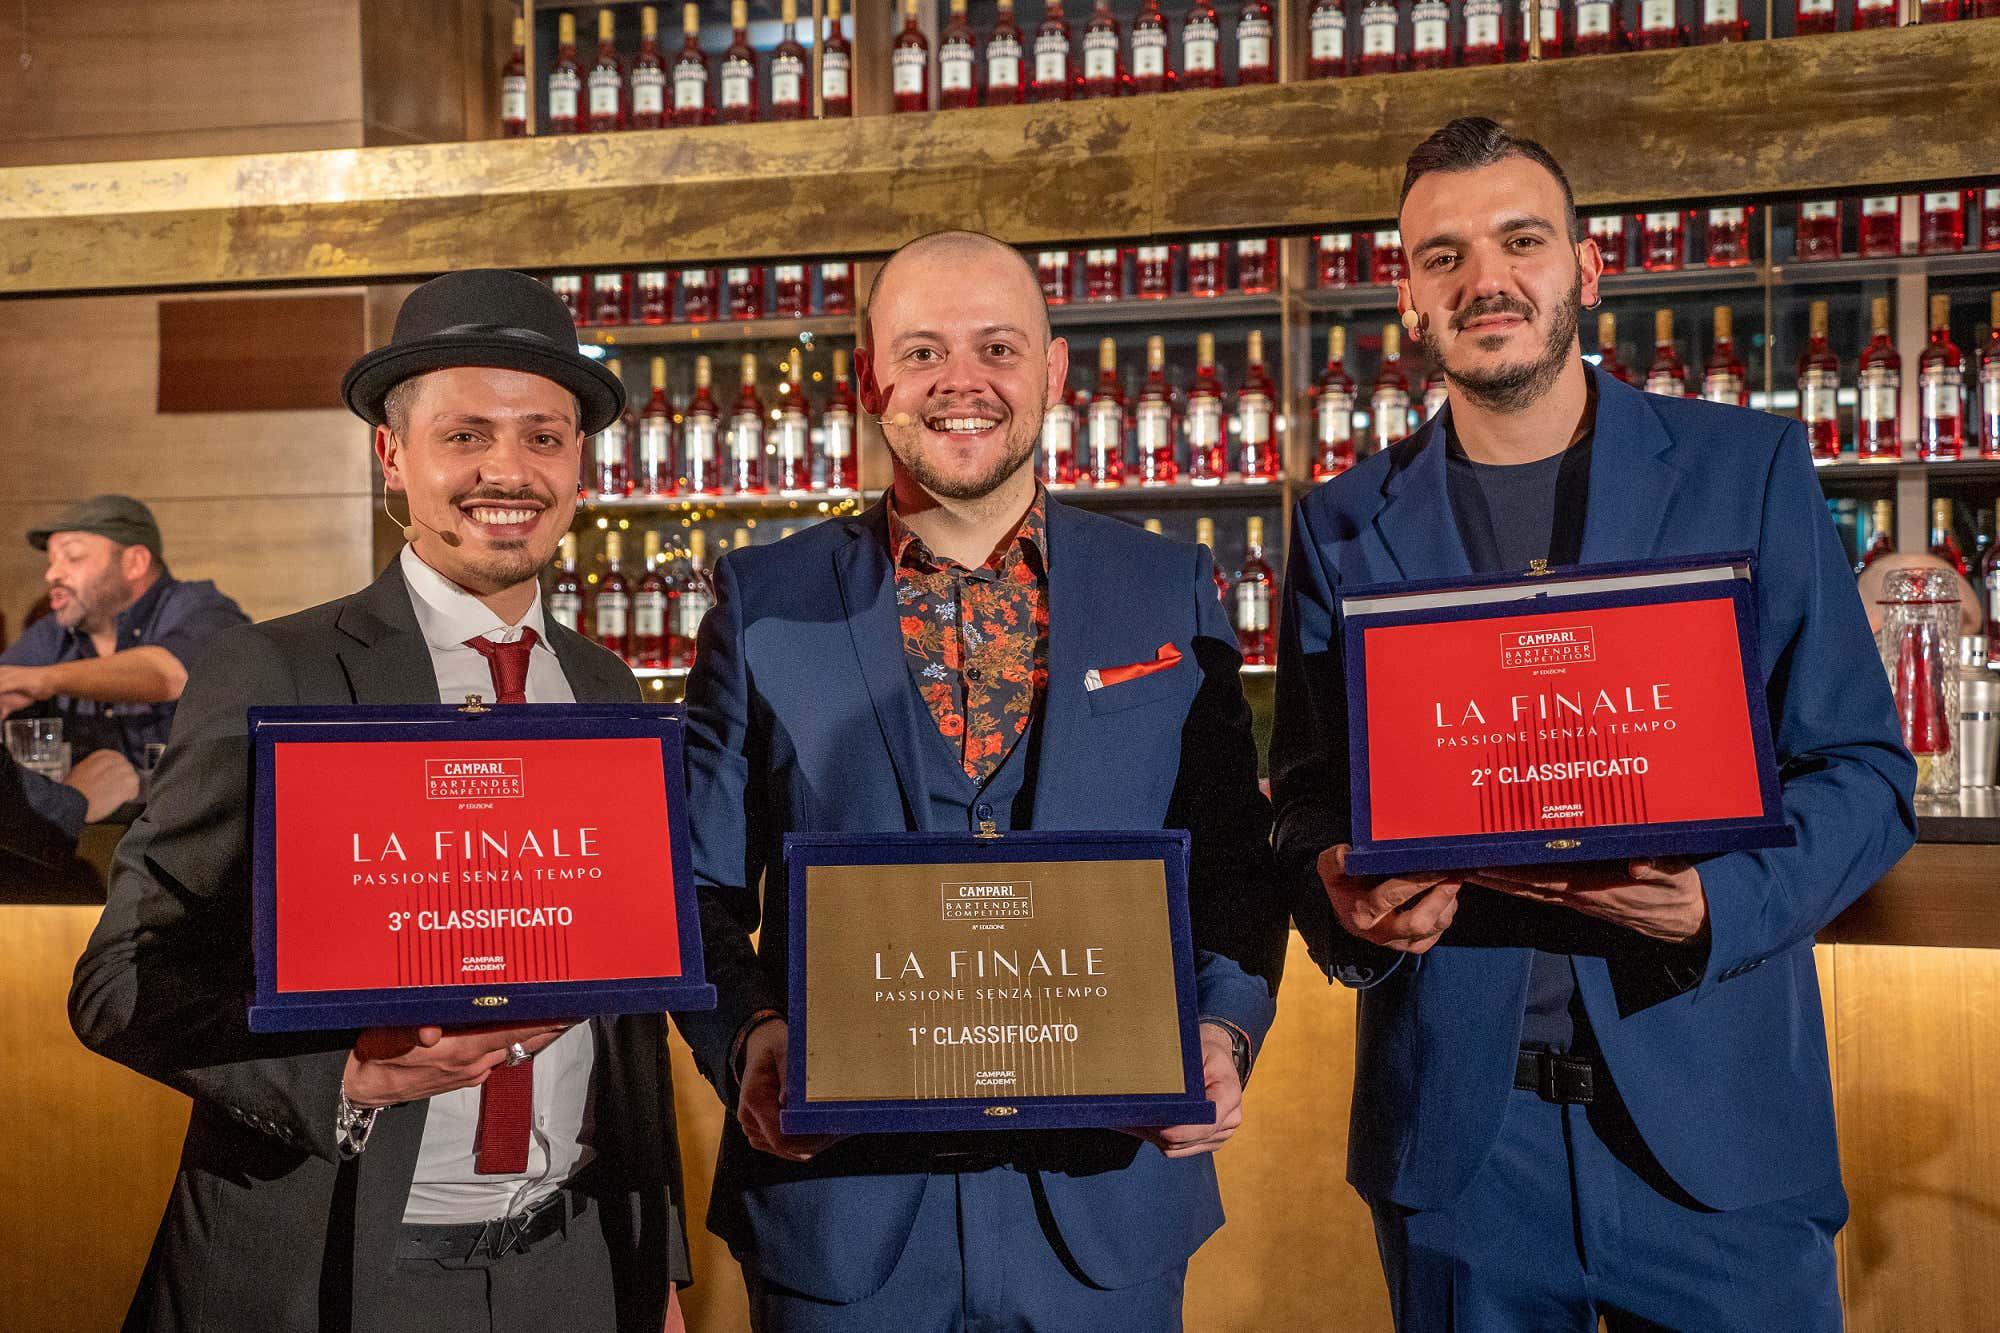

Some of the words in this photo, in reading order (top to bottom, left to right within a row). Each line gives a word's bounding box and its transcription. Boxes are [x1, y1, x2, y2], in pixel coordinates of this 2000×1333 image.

[1505, 645, 1591, 659] BARTENDER
[1506, 652, 1591, 665] COMPETITION
[1436, 699, 1486, 727] LA
[1512, 683, 1673, 722] FINALE
[1437, 731, 1528, 748] PASSIONE
[1539, 725, 1598, 740] SENZA
[1610, 719, 1677, 734] TEMPO
[1470, 769, 1492, 787] 2°
[1498, 756, 1649, 784] CLASSIFICATO
[430, 778, 519, 788] BARTENDER
[430, 787, 520, 796] COMPETITION
[1542, 803, 1583, 812] CAMPARI
[1541, 811, 1584, 819] ACADEMY
[353, 832, 407, 862] LA
[435, 827, 600, 860] FINALE
[353, 871, 451, 885] PASSIONE
[462, 869, 524, 882] SENZA
[535, 867, 602, 880] TEMPO
[945, 901, 1029, 910] BARTENDER
[388, 911, 411, 931] 3°
[417, 906, 573, 930] CLASSIFICATO
[946, 909, 1029, 917] COMPETITION
[462, 955, 505, 963] CAMPARI
[875, 951, 925, 979] LA
[950, 947, 1105, 977] FINALE
[461, 963, 506, 971] ACADEMY
[875, 989, 965, 1002] PASSIONE
[975, 988, 1033, 1001] SENZA
[1044, 986, 1108, 998] TEMPO
[908, 1027, 927, 1046] 1°
[933, 1023, 1079, 1045] CLASSIFICATO
[975, 1070, 1016, 1078] CAMPARI
